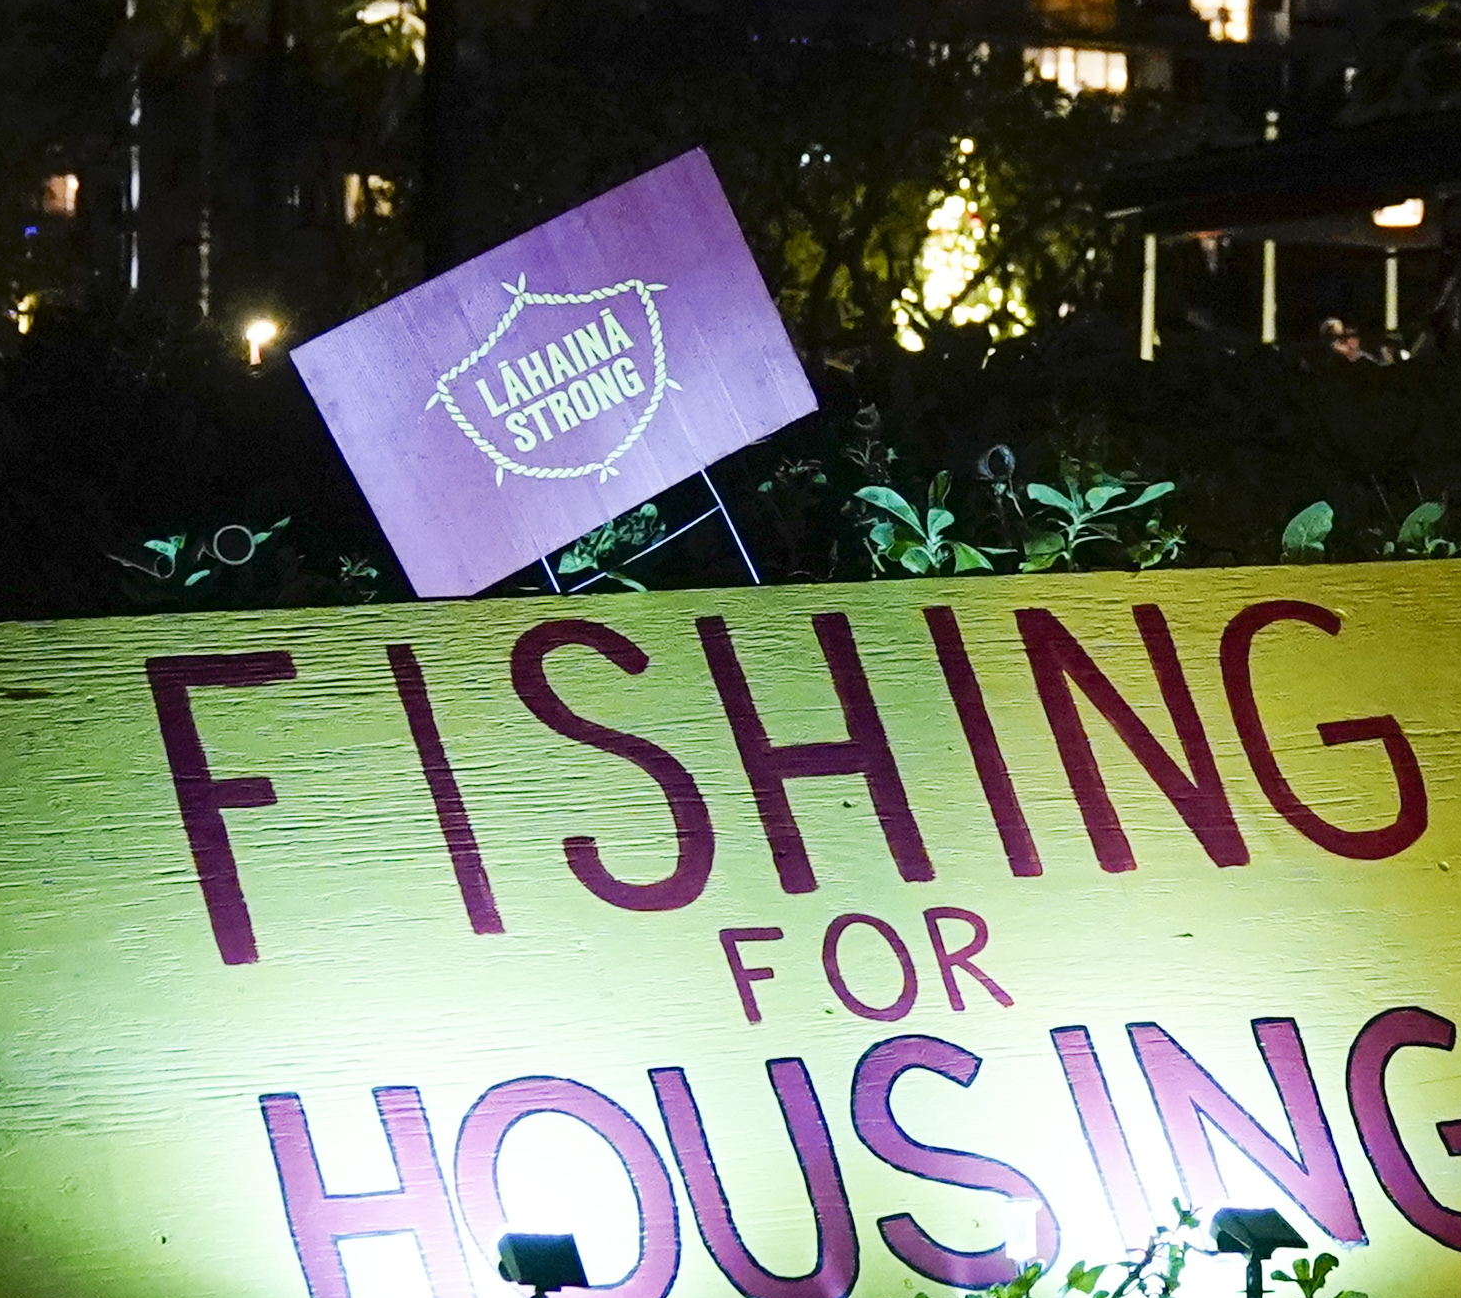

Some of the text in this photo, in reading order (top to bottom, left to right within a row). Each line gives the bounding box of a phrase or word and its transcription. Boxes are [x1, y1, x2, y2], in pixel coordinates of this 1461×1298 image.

[504, 356, 646, 452] STRONG
[143, 598, 1430, 967] FISHING
[718, 903, 1016, 1025] FOR
